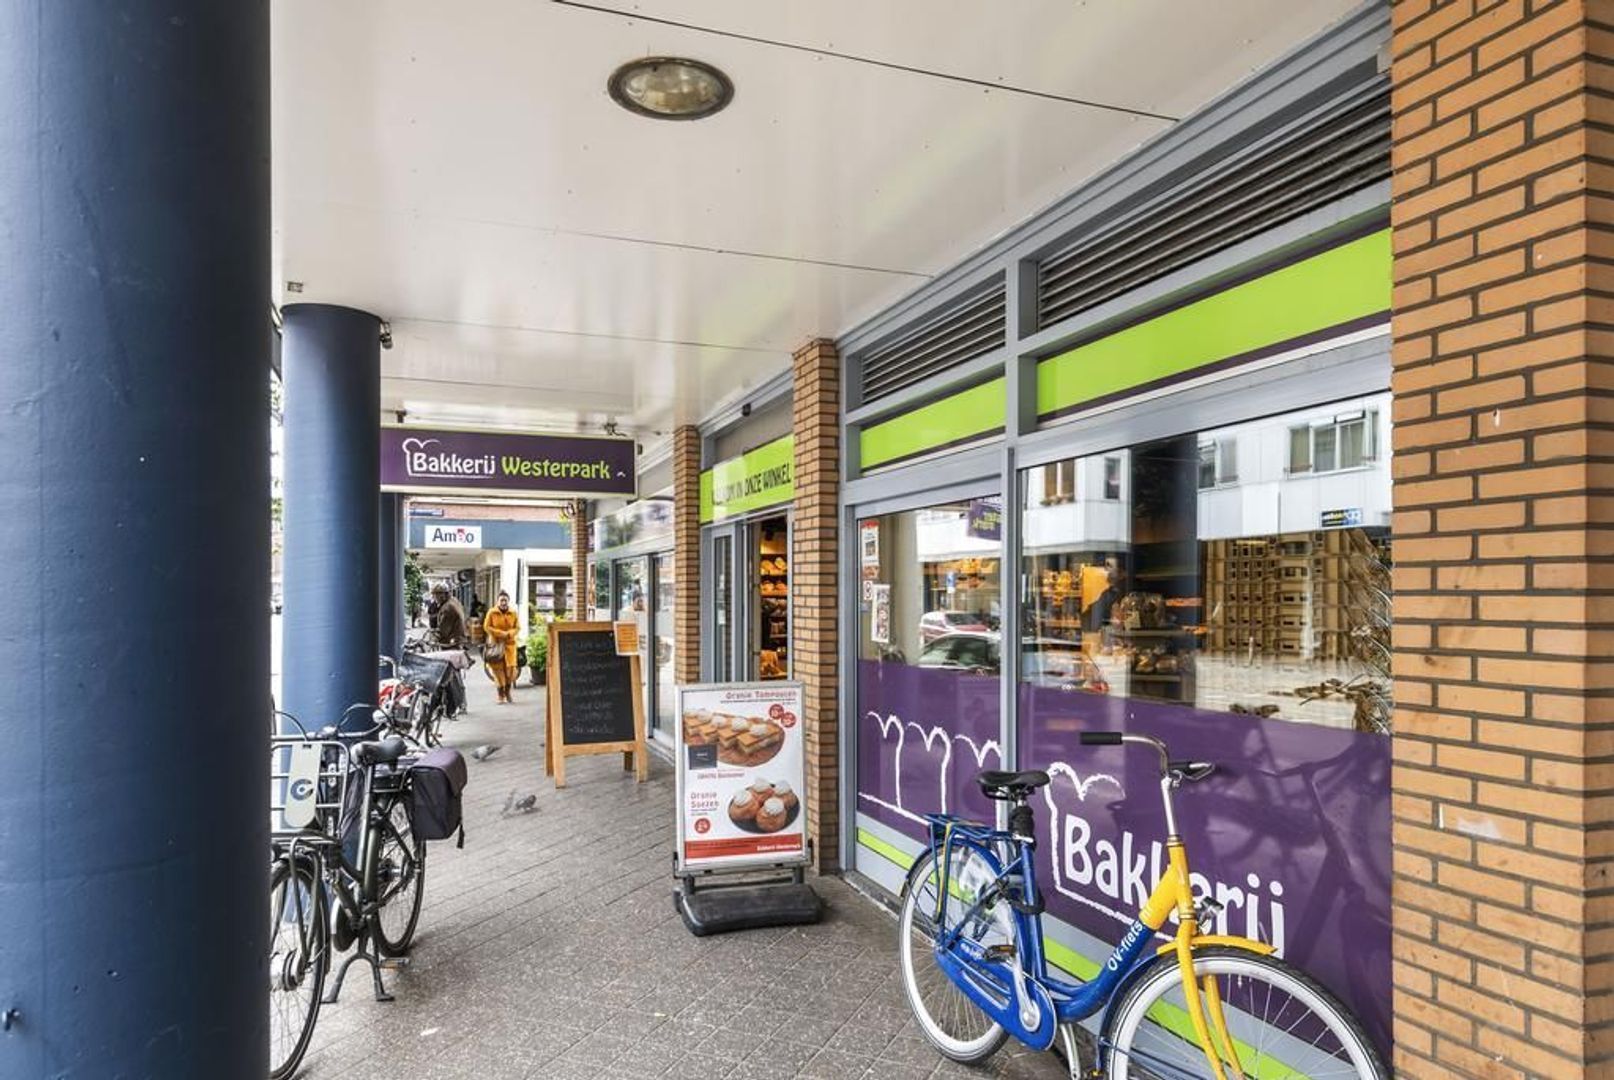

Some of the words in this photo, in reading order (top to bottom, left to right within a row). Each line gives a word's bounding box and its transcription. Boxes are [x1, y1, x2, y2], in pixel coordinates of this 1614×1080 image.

[413, 453, 496, 475] Bakkerij
[501, 455, 611, 479] Westerpark
[763, 462, 791, 490] WINKEL
[1108, 920, 1143, 971] OV-fiets
